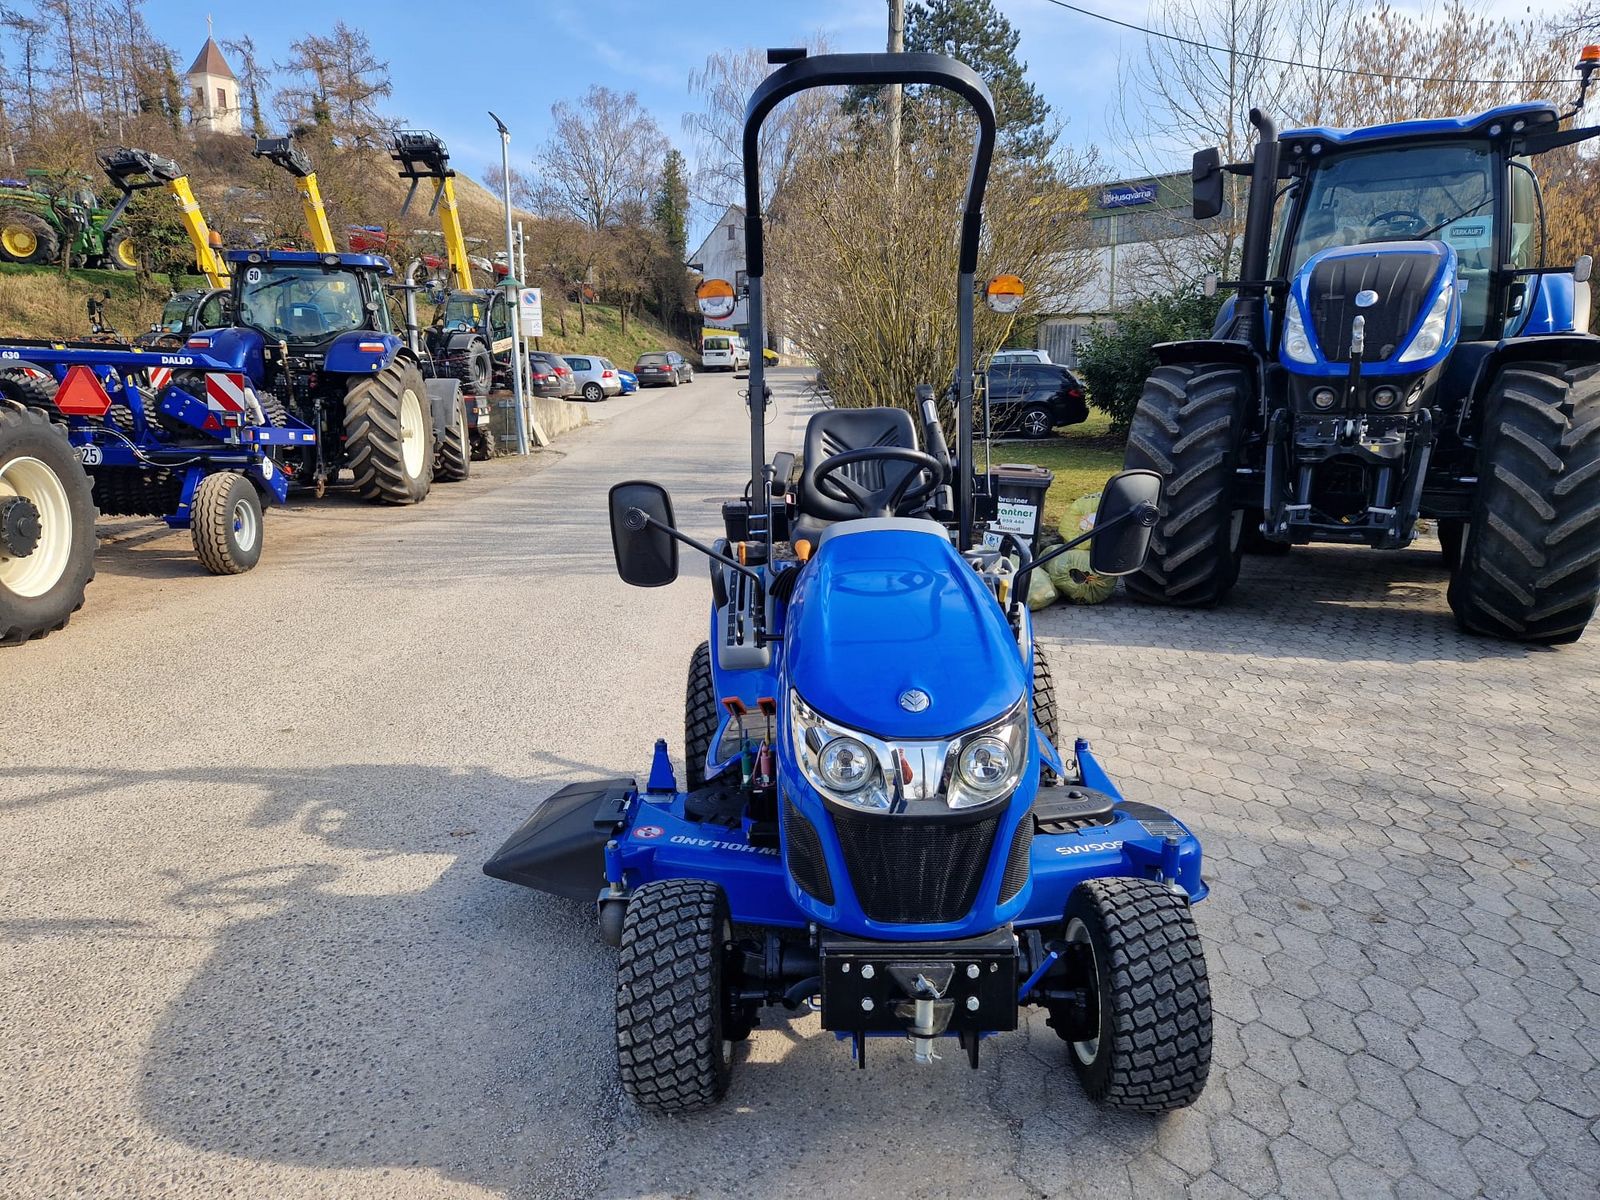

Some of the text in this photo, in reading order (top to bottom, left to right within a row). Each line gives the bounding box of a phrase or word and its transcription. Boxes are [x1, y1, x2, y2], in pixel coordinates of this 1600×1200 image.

[1110, 190, 1151, 203] Husqvarna
[1452, 227, 1483, 236] VERKAUFT
[249, 270, 259, 281] 50
[1, 350, 20, 360] 630
[161, 356, 194, 365] DALBO
[82, 448, 98, 464] 25
[996, 508, 1034, 517] rantner
[669, 835, 757, 853] HOLLAND
